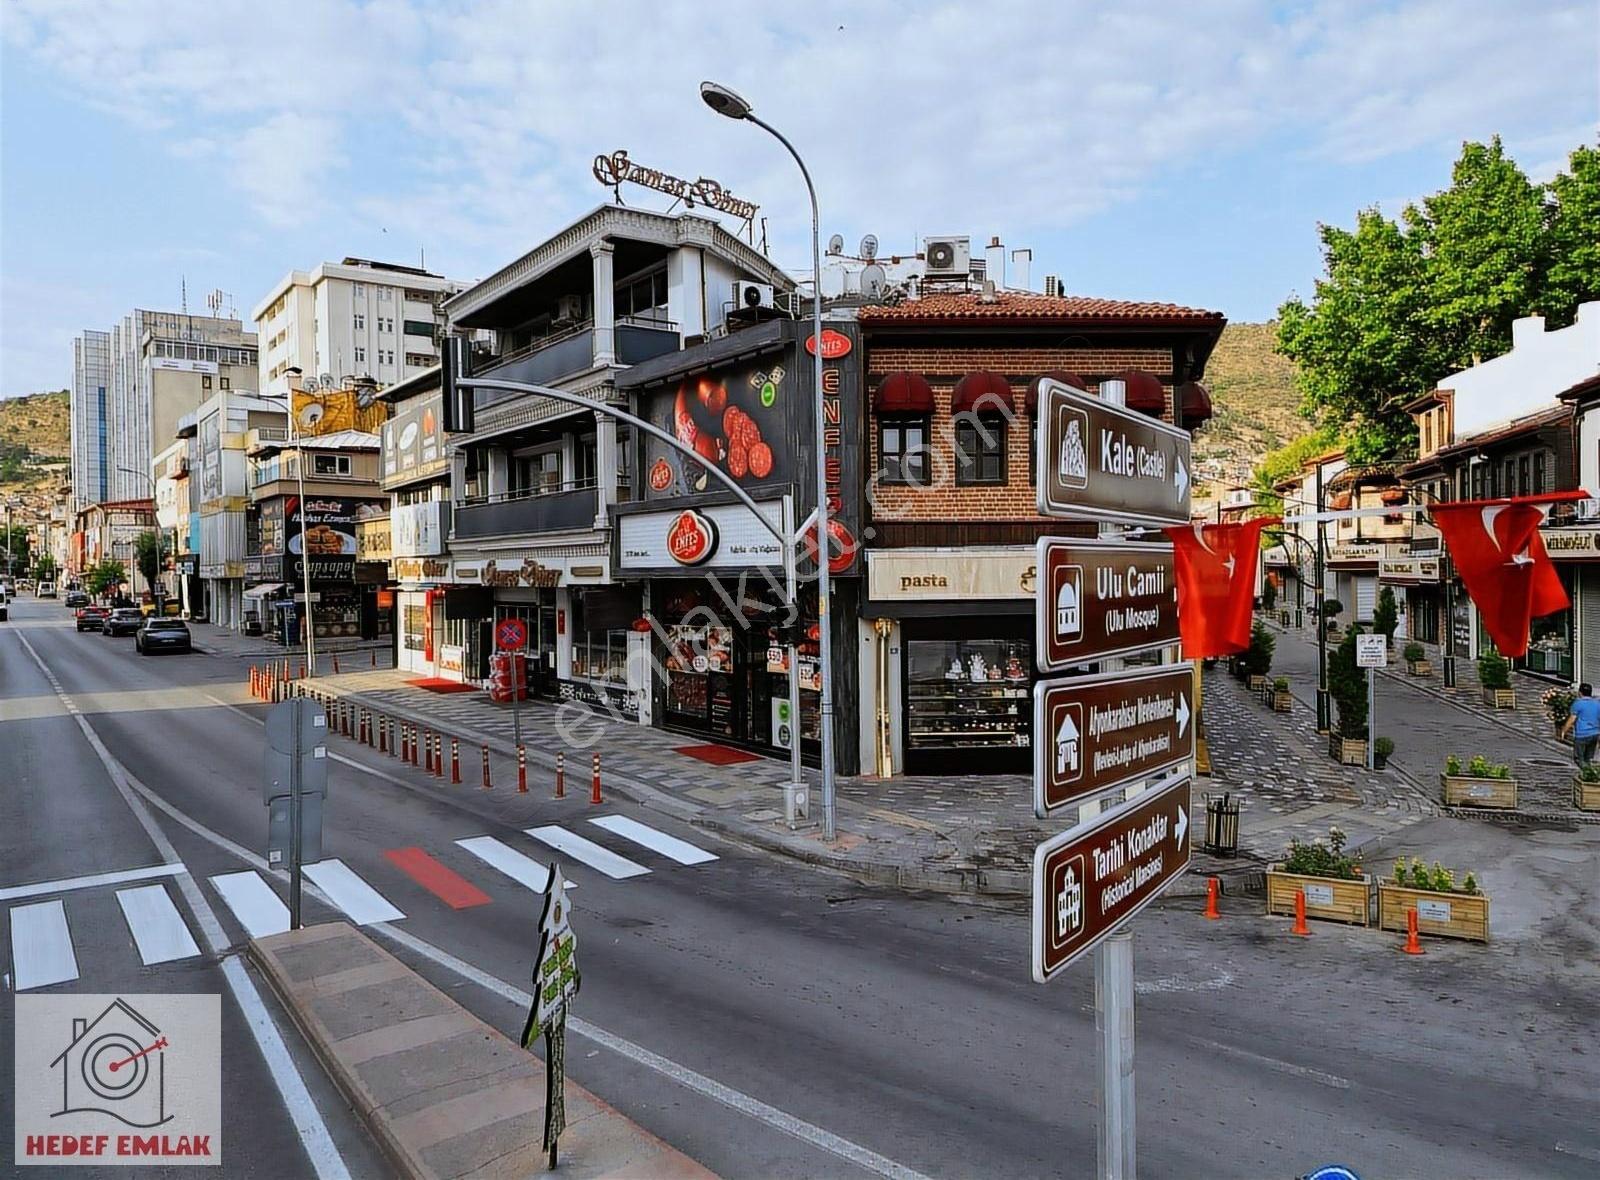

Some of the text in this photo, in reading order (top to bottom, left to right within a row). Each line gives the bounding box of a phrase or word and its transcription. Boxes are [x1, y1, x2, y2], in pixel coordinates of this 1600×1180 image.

[1101, 428, 1166, 482] Kale (Castle)
[900, 574, 947, 591] pasta
[1097, 565, 1164, 600] Ulu Camii
[1105, 604, 1159, 636] (Ulu Mosque)
[1092, 813, 1168, 881] Tarihi Konaklar
[1101, 850, 1163, 916] (Historical Mansions)
